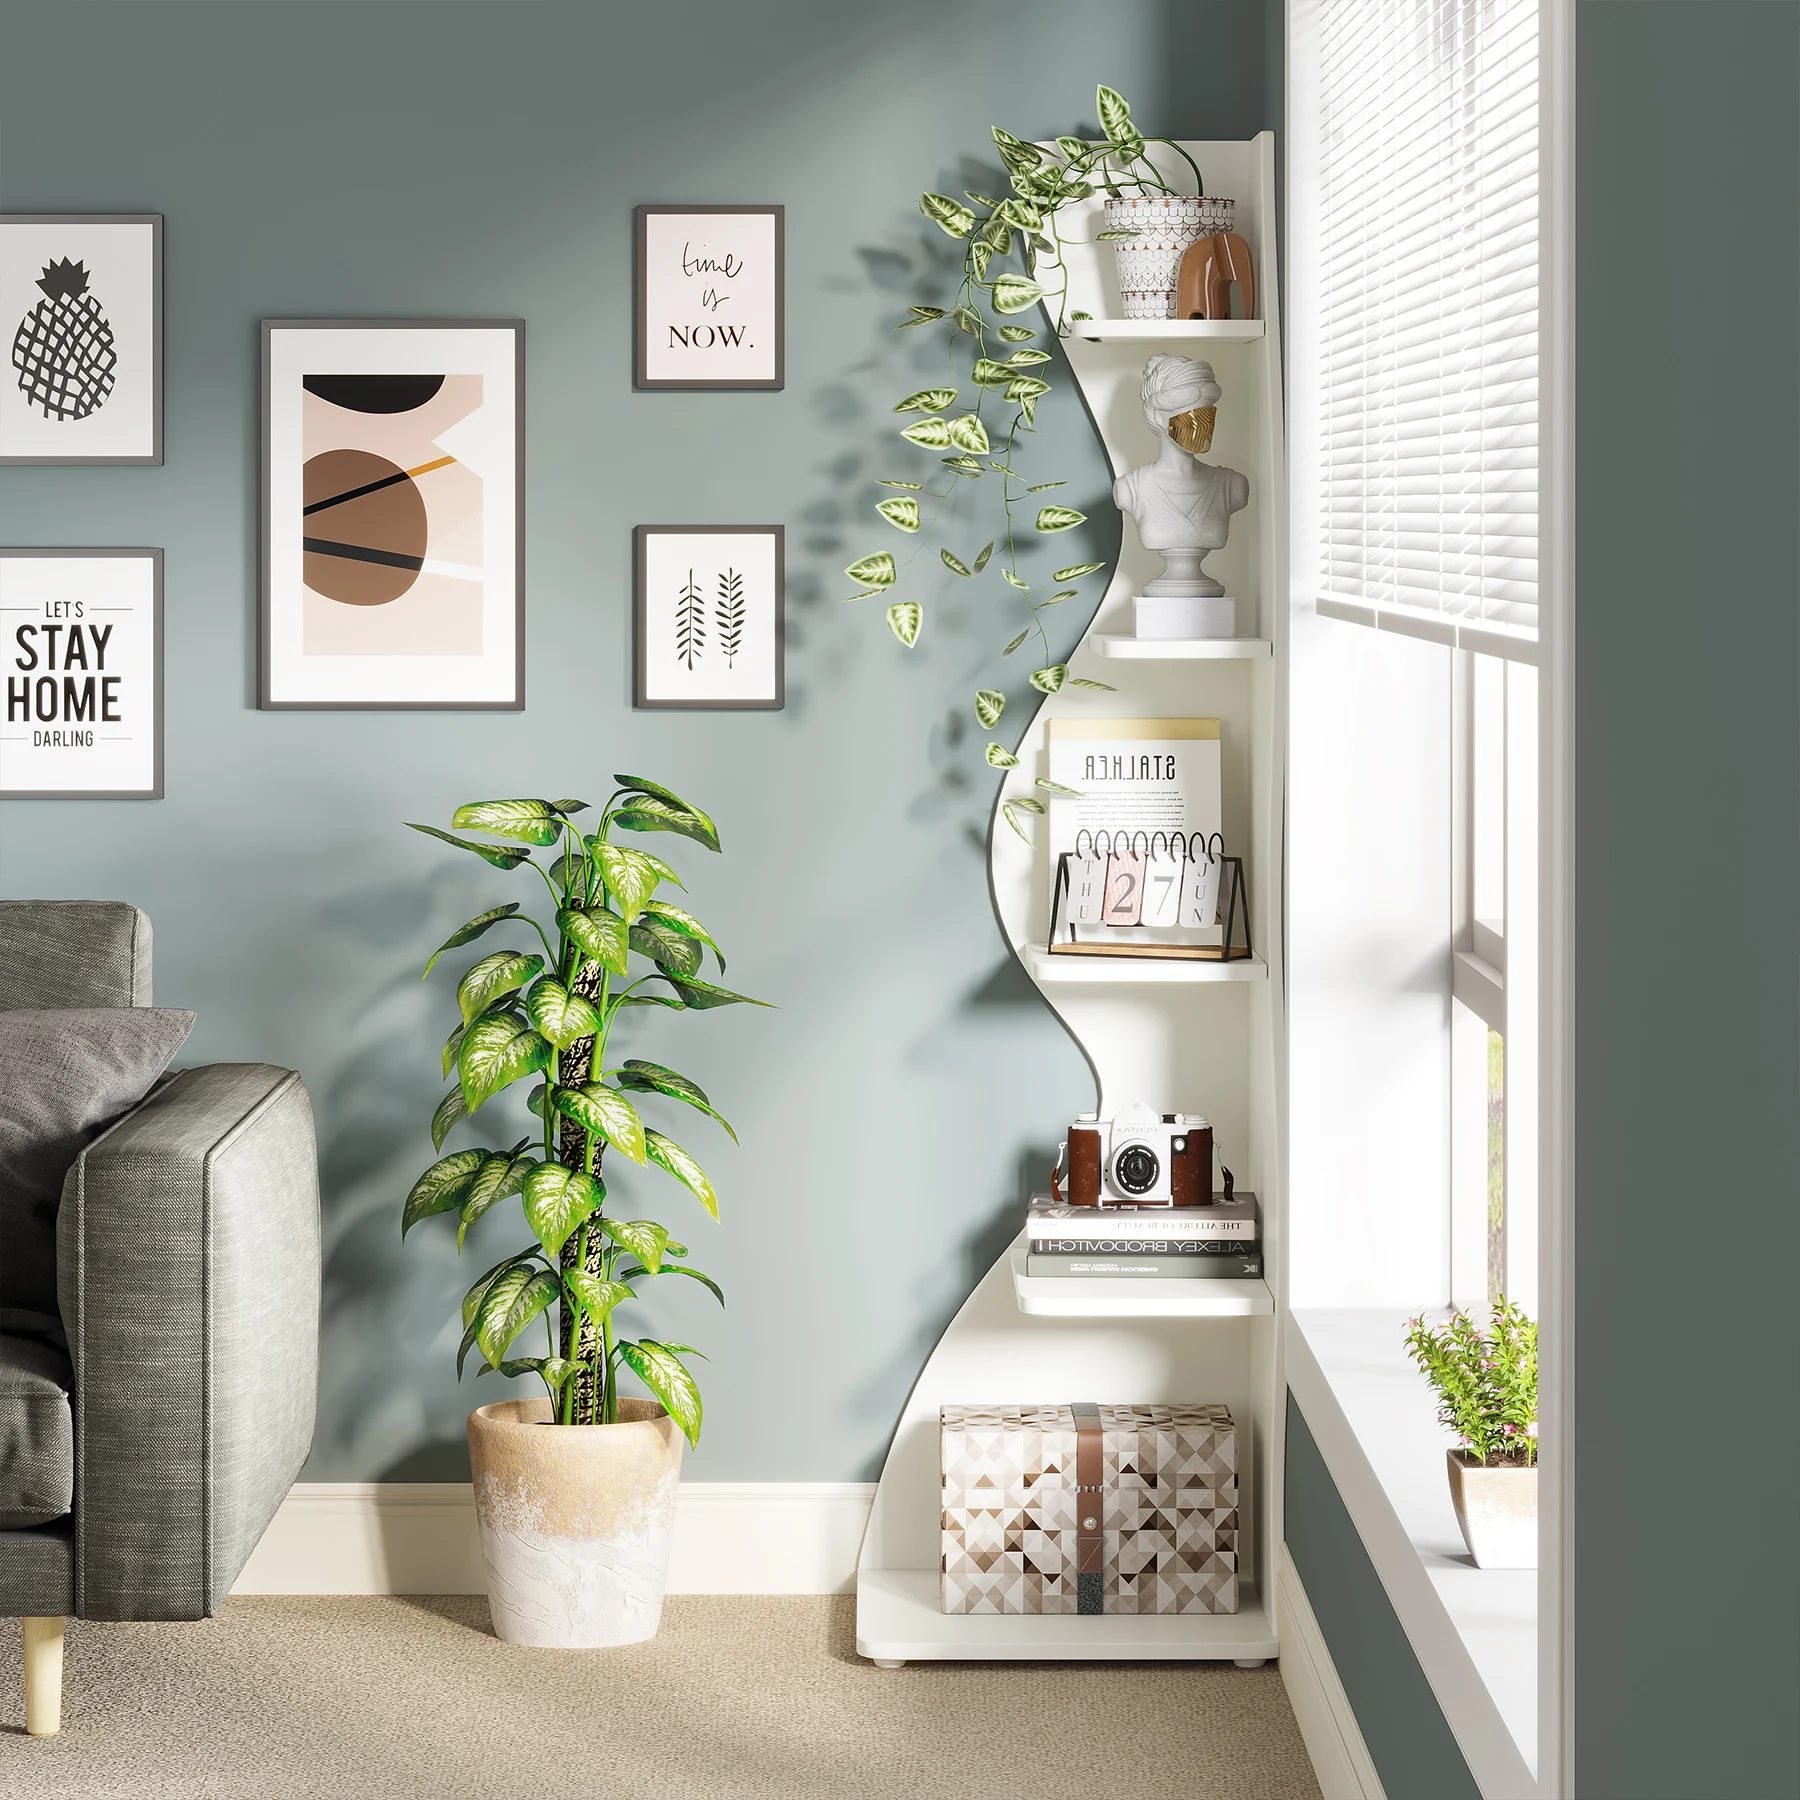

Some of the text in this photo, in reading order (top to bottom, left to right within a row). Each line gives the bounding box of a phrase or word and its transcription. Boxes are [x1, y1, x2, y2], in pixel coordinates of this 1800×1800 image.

[681, 241, 743, 278] time
[702, 282, 730, 312] is
[667, 324, 754, 349] NOW.
[45, 601, 84, 618] LET'S
[15, 623, 114, 671] STAY
[7, 675, 122, 722] HOME
[33, 730, 94, 747] DARLING
